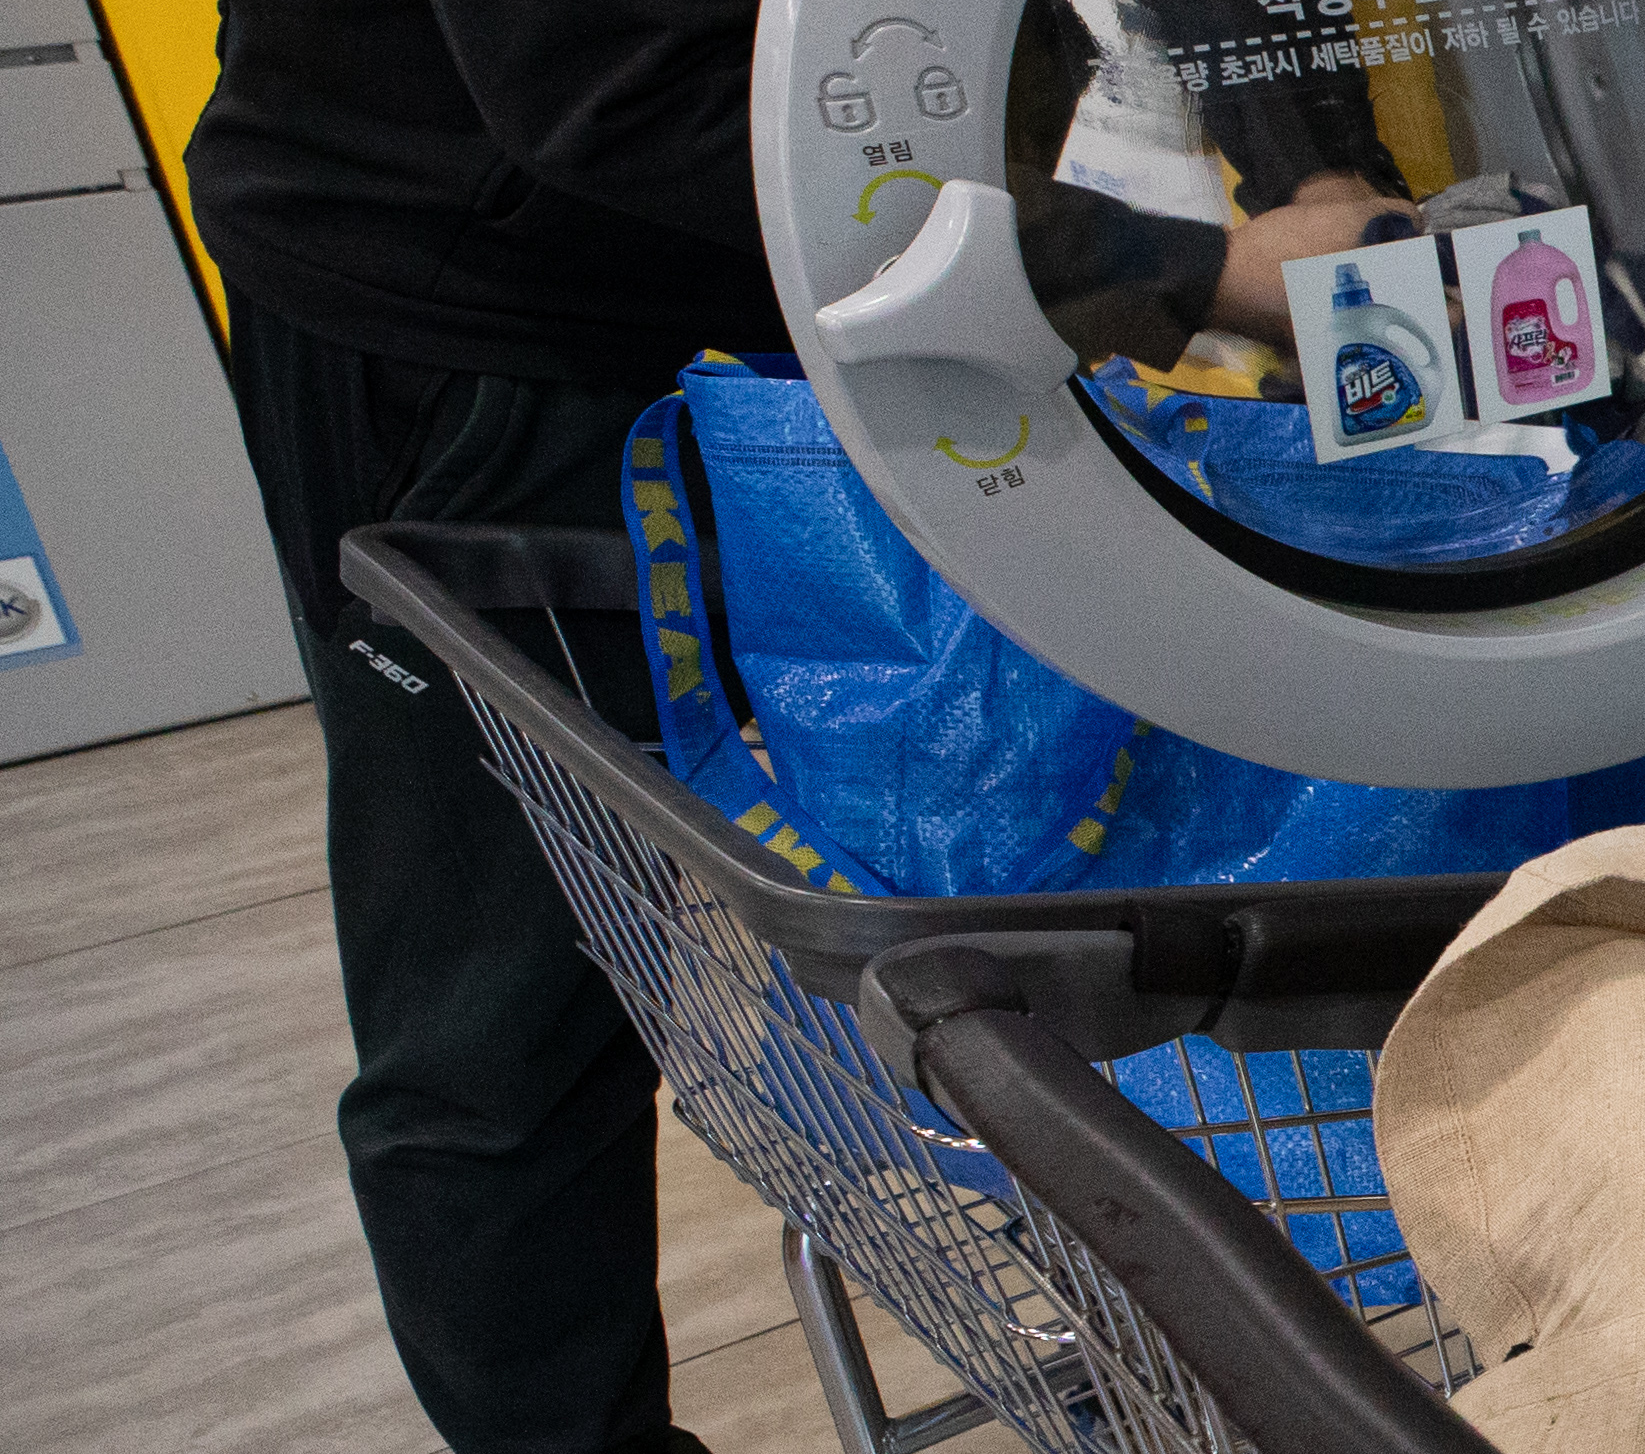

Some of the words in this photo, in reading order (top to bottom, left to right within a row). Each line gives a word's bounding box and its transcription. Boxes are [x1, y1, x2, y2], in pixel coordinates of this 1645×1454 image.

[860, 138, 914, 168] 열림
[973, 466, 1028, 499] 닫힘
[631, 438, 704, 702] IKEA
[349, 639, 429, 694] F-360
